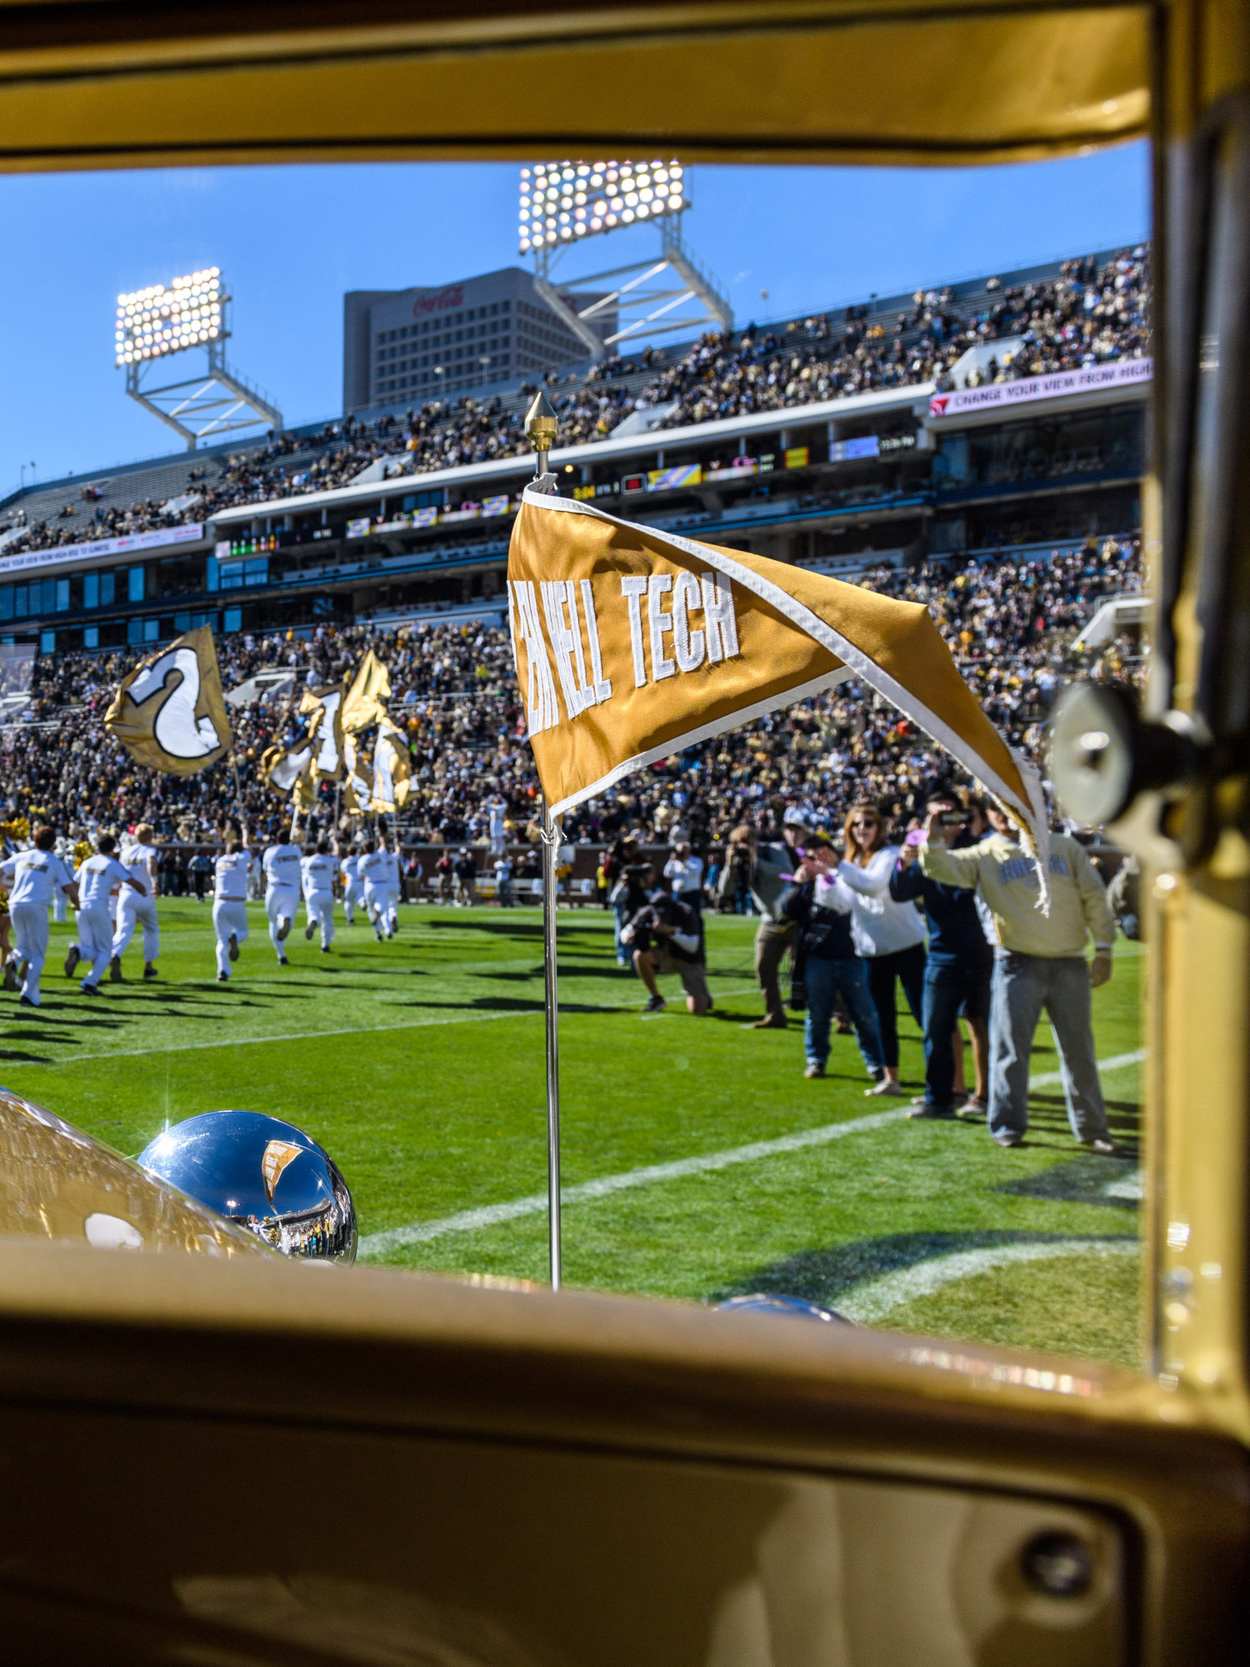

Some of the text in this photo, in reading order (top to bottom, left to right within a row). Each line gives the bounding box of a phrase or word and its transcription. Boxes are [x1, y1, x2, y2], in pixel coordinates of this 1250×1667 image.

[954, 390, 1002, 407] CHANGE
[1007, 383, 1040, 398] YOUR
[1042, 376, 1075, 391] VIEW
[1079, 370, 1115, 385] FROM
[621, 571, 740, 688] TECH
